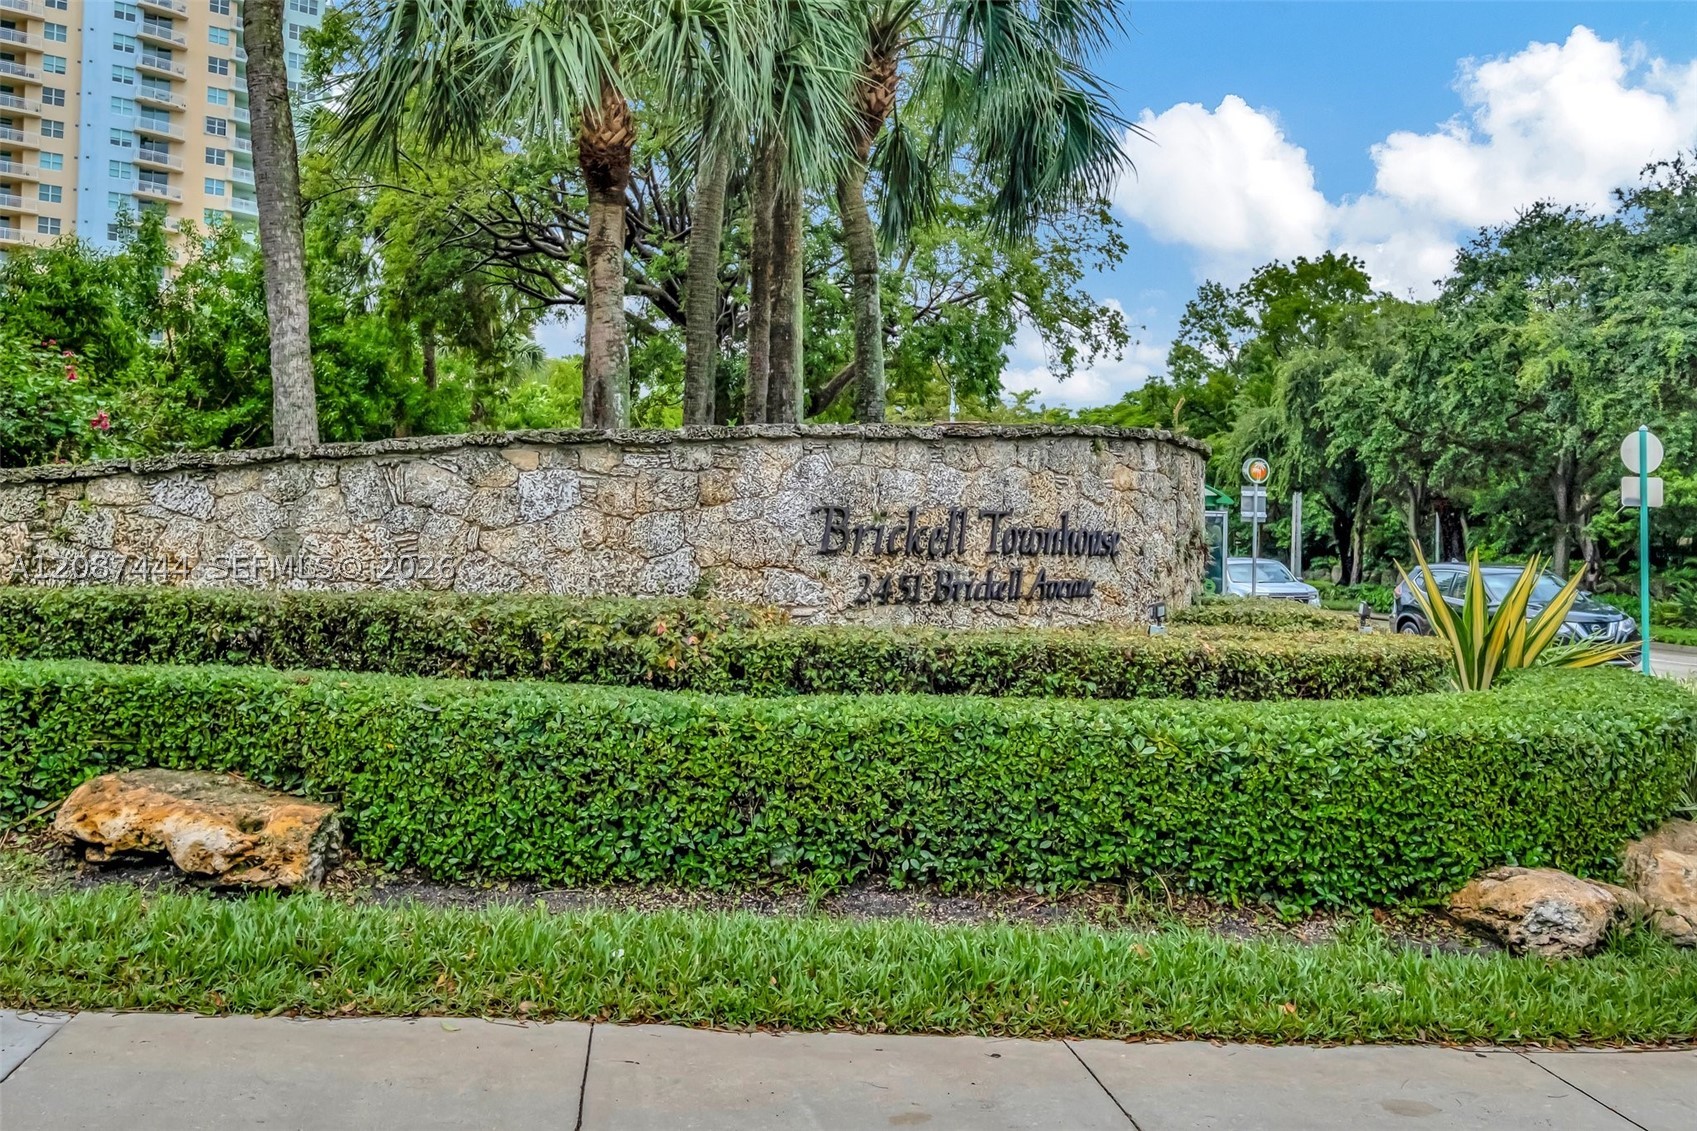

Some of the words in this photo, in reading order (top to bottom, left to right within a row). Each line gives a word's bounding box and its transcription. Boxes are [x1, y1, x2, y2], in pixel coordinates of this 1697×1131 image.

[811, 505, 967, 556] Brickell
[979, 508, 1121, 557] Townhouse
[857, 573, 922, 602] 2451
[933, 567, 1023, 602] Brickell
